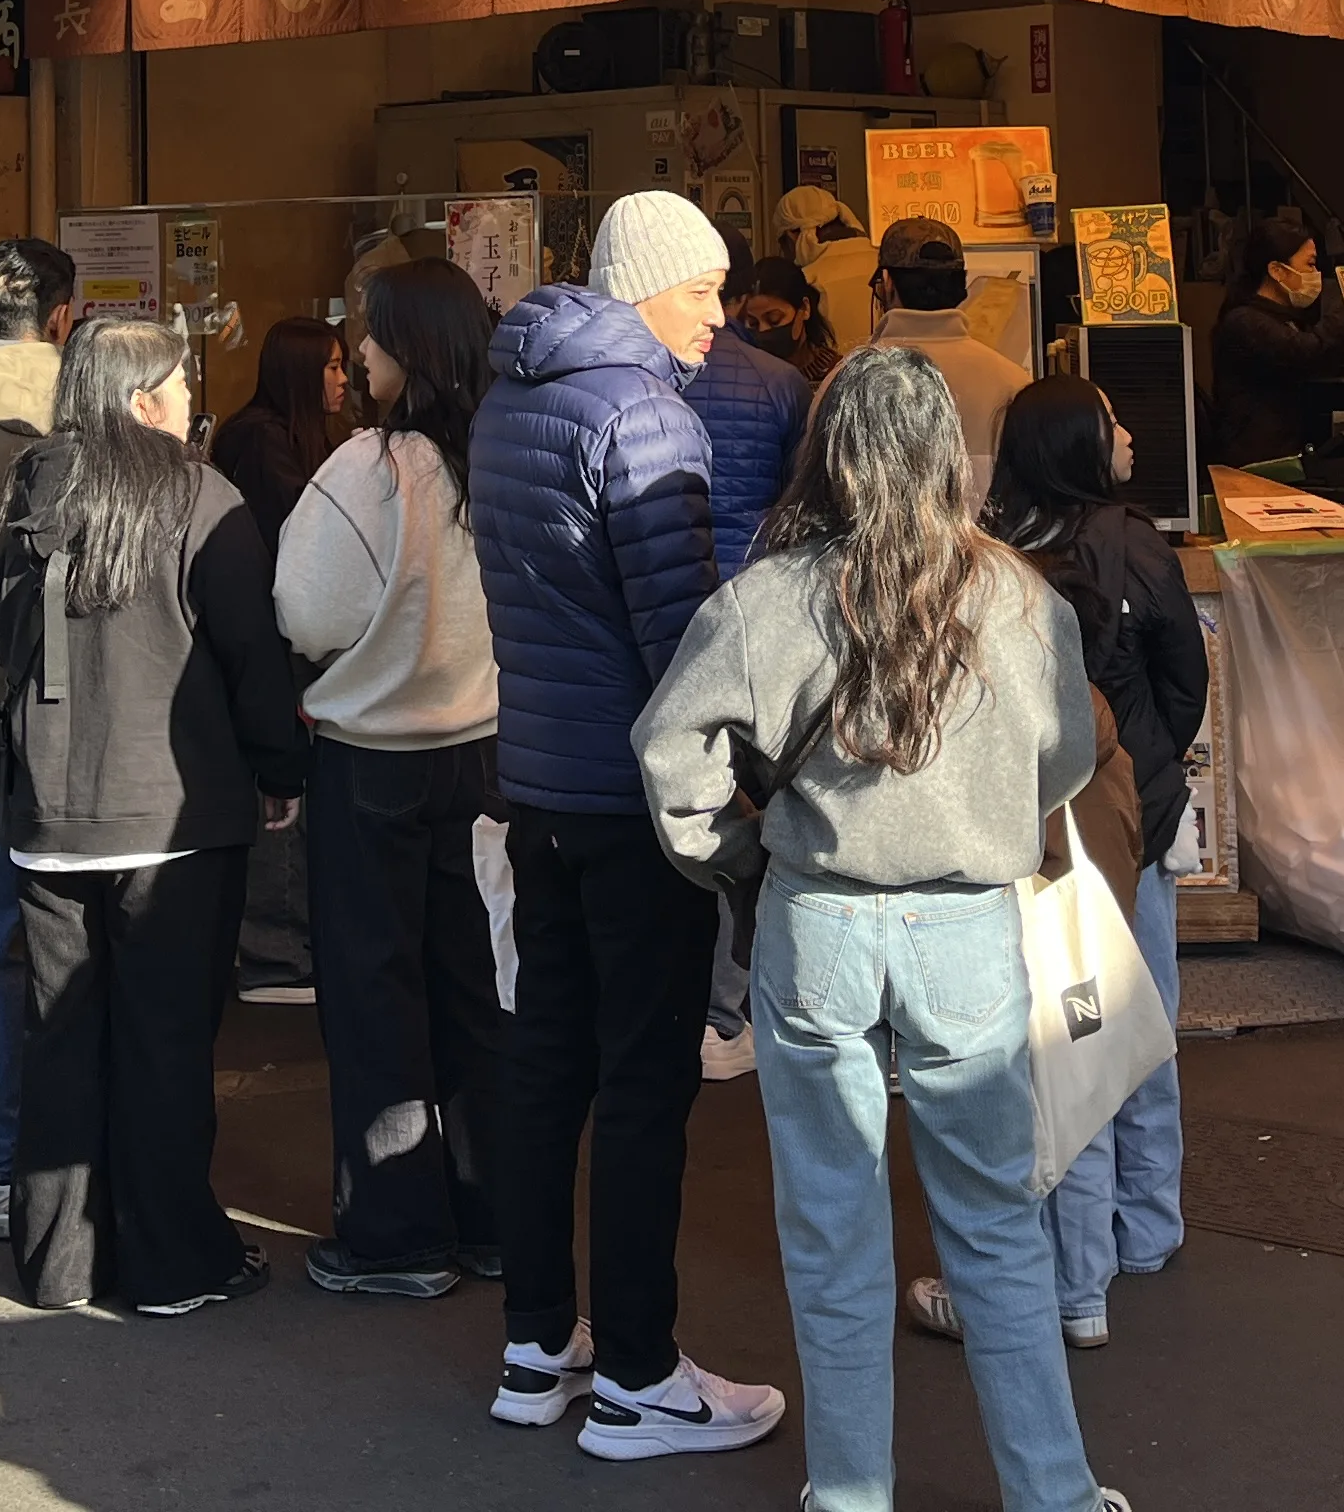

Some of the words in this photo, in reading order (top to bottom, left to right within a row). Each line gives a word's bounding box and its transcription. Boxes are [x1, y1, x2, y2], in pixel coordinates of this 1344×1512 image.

[881, 141, 955, 160] BEER
[173, 226, 212, 242] 生ビール
[175, 243, 209, 258] Beer
[508, 219, 520, 278] お正月用
[1091, 290, 1171, 313] 500円
